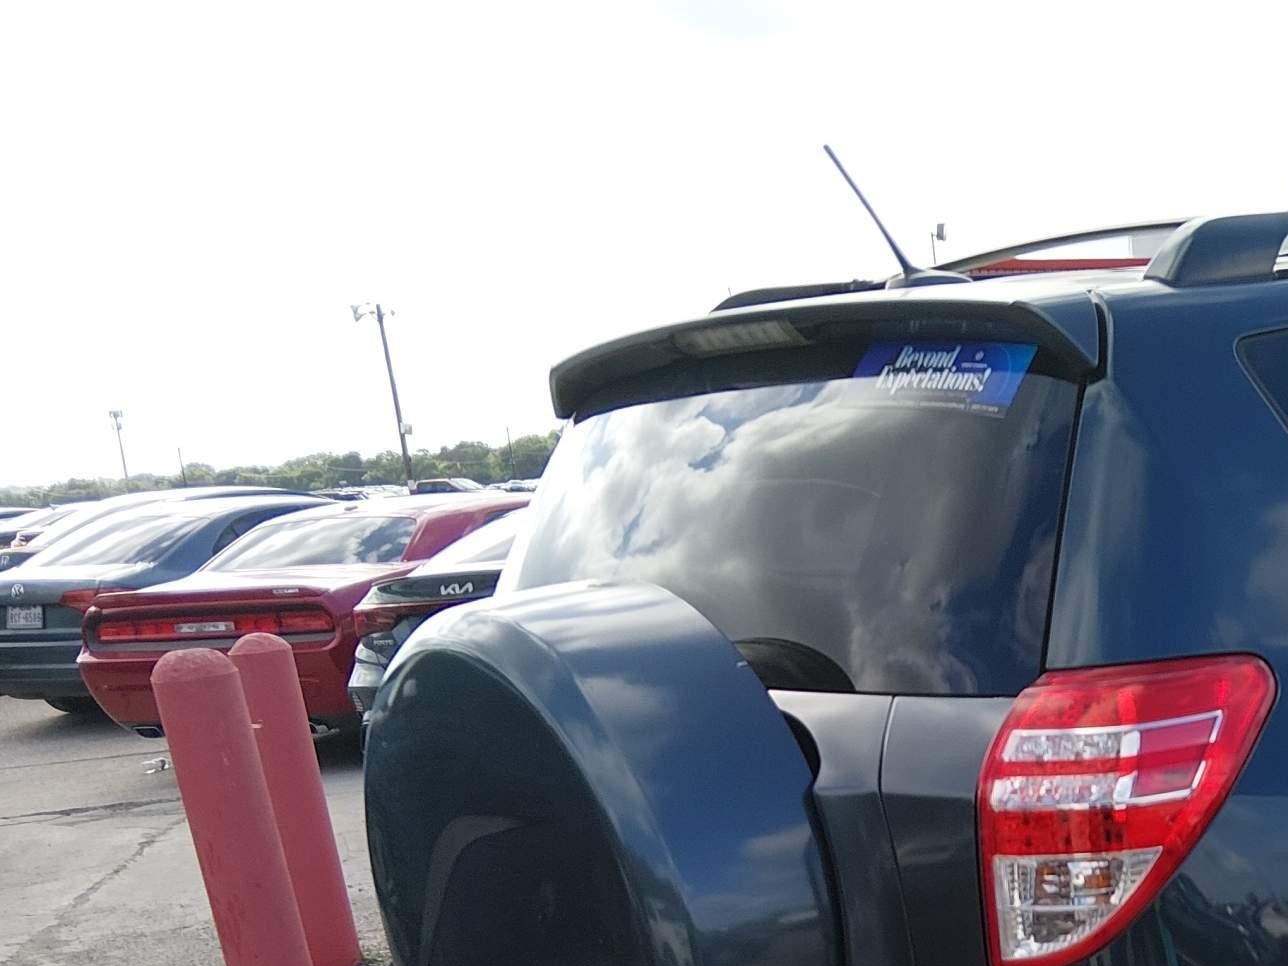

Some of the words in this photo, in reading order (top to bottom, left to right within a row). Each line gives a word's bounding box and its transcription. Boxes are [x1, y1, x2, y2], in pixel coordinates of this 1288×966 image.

[895, 344, 961, 370] Beyond
[875, 365, 992, 396] Expectations!
[440, 582, 473, 596] KIA
